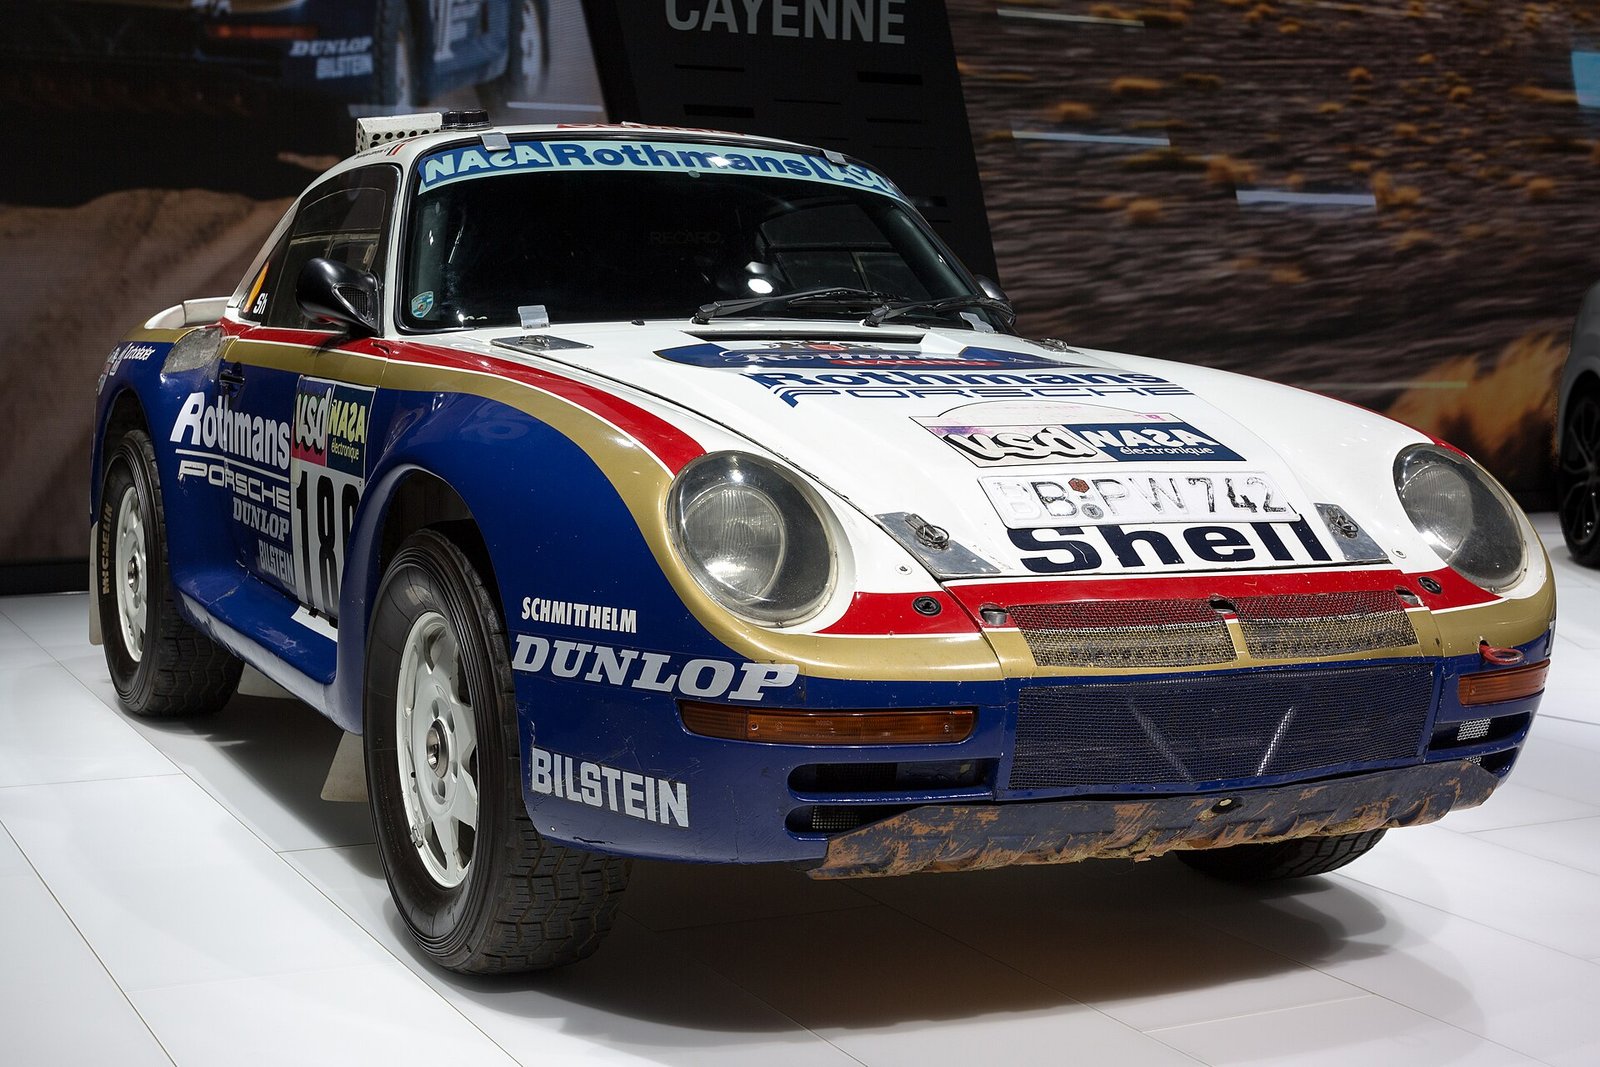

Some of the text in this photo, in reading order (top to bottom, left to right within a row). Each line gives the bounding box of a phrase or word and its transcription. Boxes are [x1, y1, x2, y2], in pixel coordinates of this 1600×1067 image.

[665, 0, 905, 44] CAYENNE
[549, 143, 812, 177] Rothmans
[738, 371, 1170, 390] Rothmans
[780, 387, 1195, 408] PORSCHE
[170, 391, 290, 471] Rothmans
[178, 460, 290, 513] PORSCHE
[233, 496, 290, 542] DUNLOP
[258, 539, 295, 587] BILSTEIN
[1007, 516, 1333, 573] Shell
[521, 596, 638, 633] SCHMITTHELM
[511, 634, 800, 701] DUNLOP
[531, 746, 689, 829] BILSTEIN
